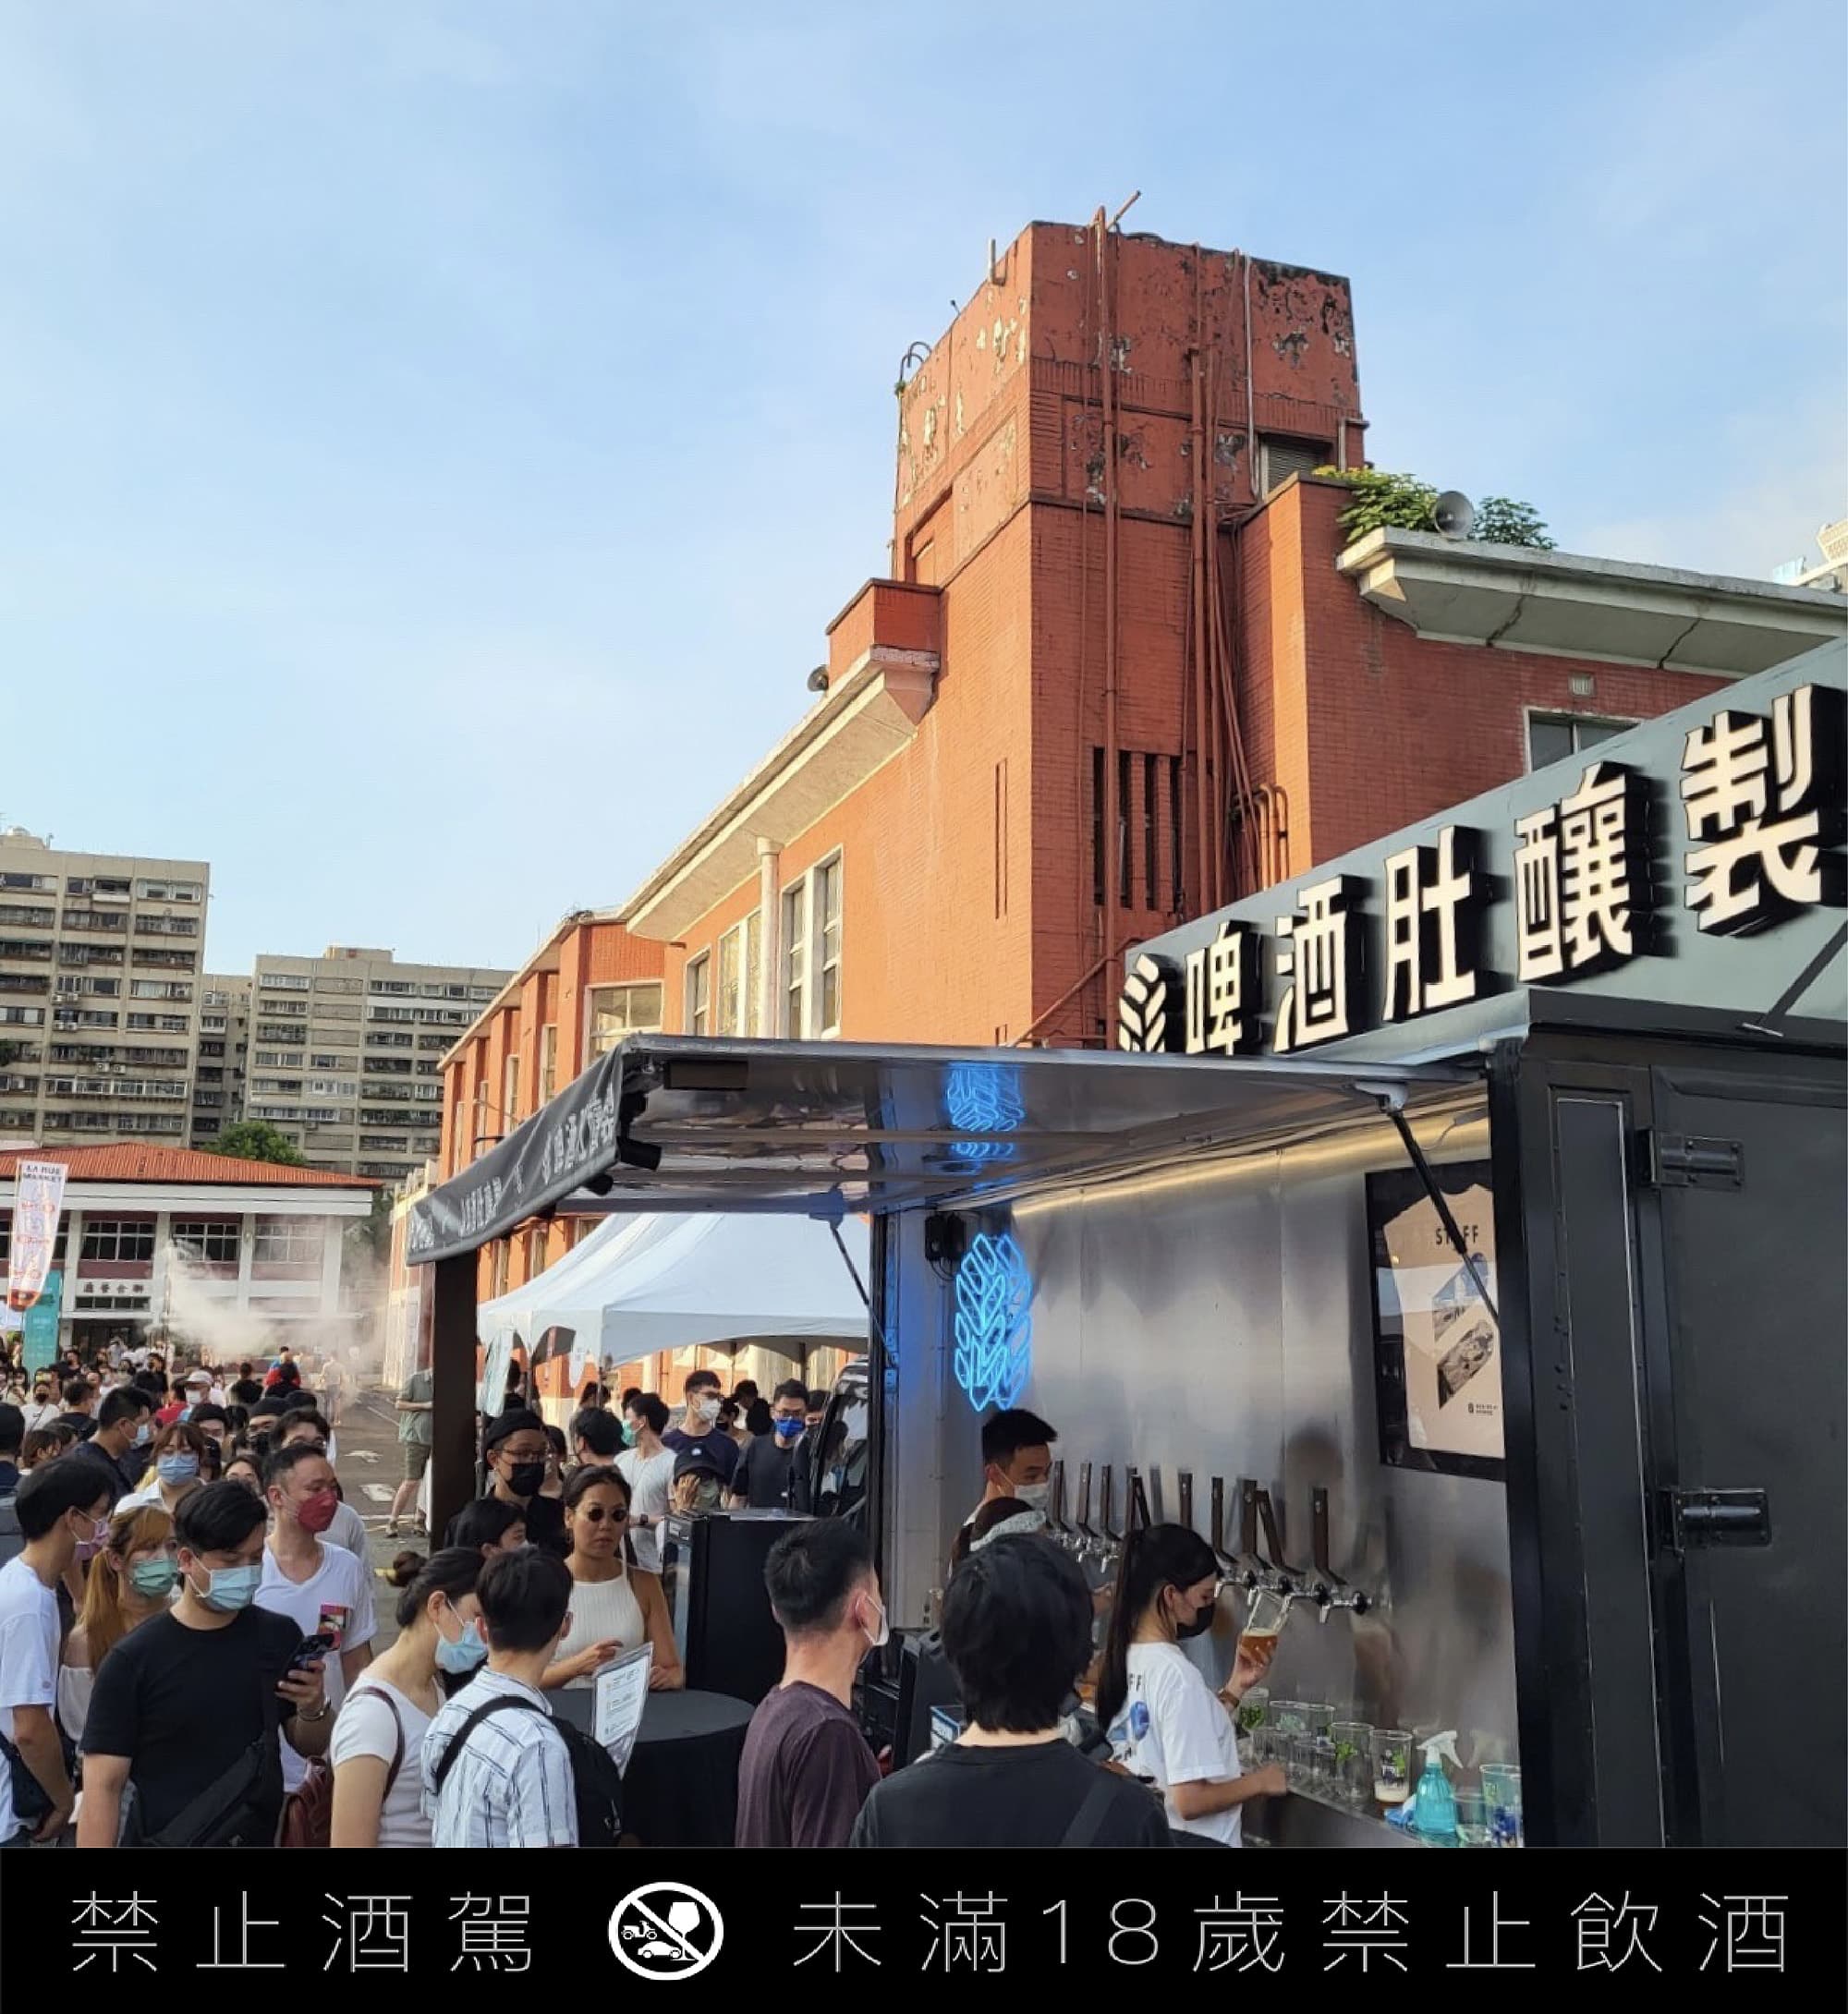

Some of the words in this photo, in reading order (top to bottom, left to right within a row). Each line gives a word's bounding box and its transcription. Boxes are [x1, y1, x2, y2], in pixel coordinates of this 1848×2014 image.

[1185, 683, 1824, 1056] 啤酒肚釀製
